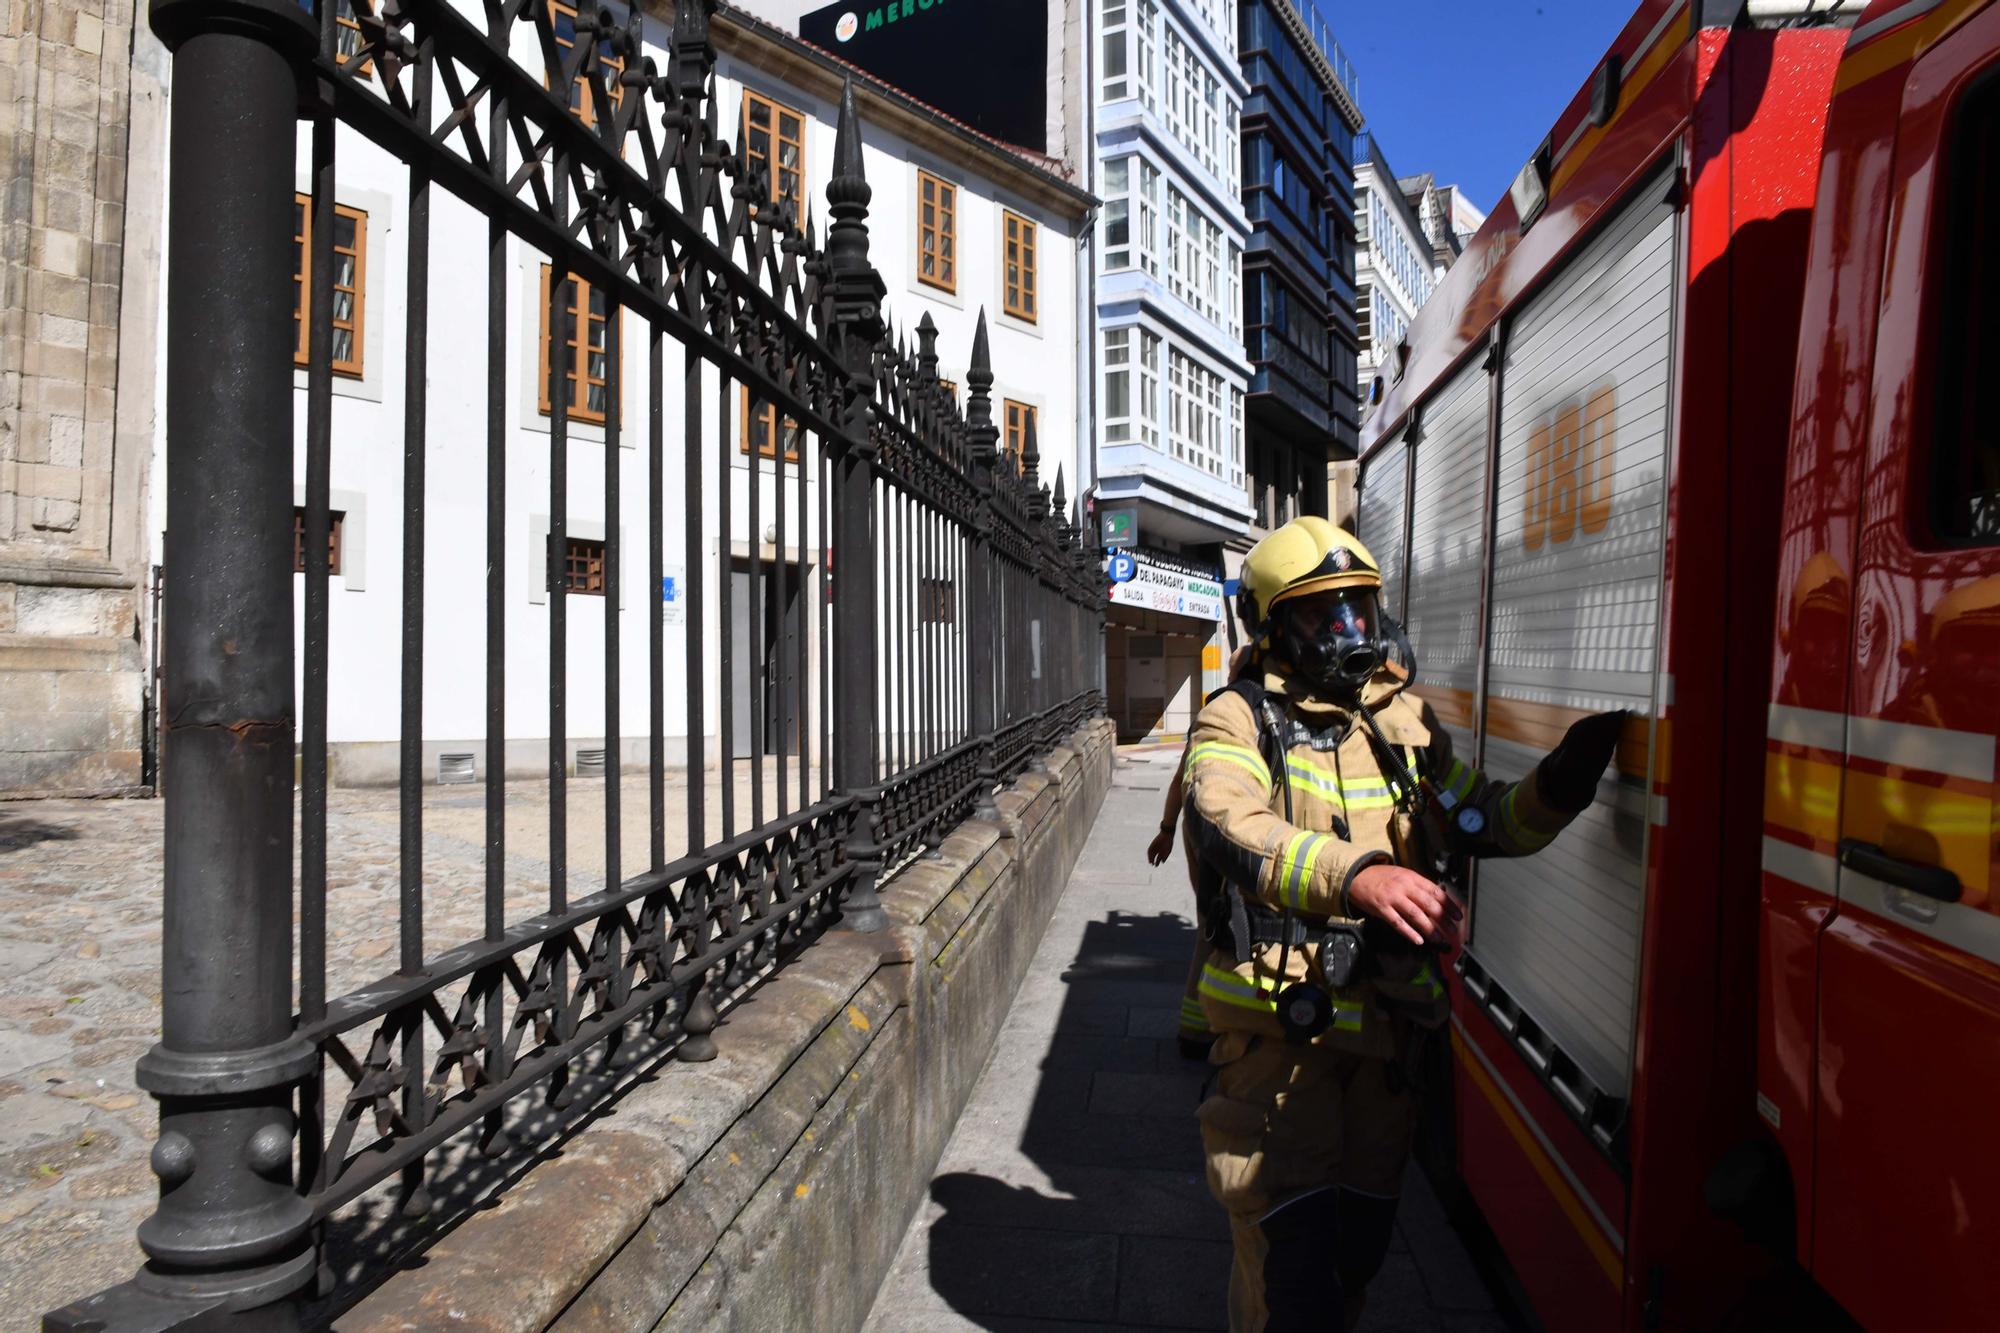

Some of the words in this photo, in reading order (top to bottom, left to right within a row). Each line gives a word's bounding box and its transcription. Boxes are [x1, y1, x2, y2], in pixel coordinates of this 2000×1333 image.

[1523, 382, 1616, 553] 080
[1115, 559, 1129, 578] P
[1152, 571, 1184, 590] PAPAGAYO
[1188, 581, 1220, 597] MERCADONA
[1124, 588, 1144, 601] SALIDA
[1189, 602, 1210, 614] ENTRADA
